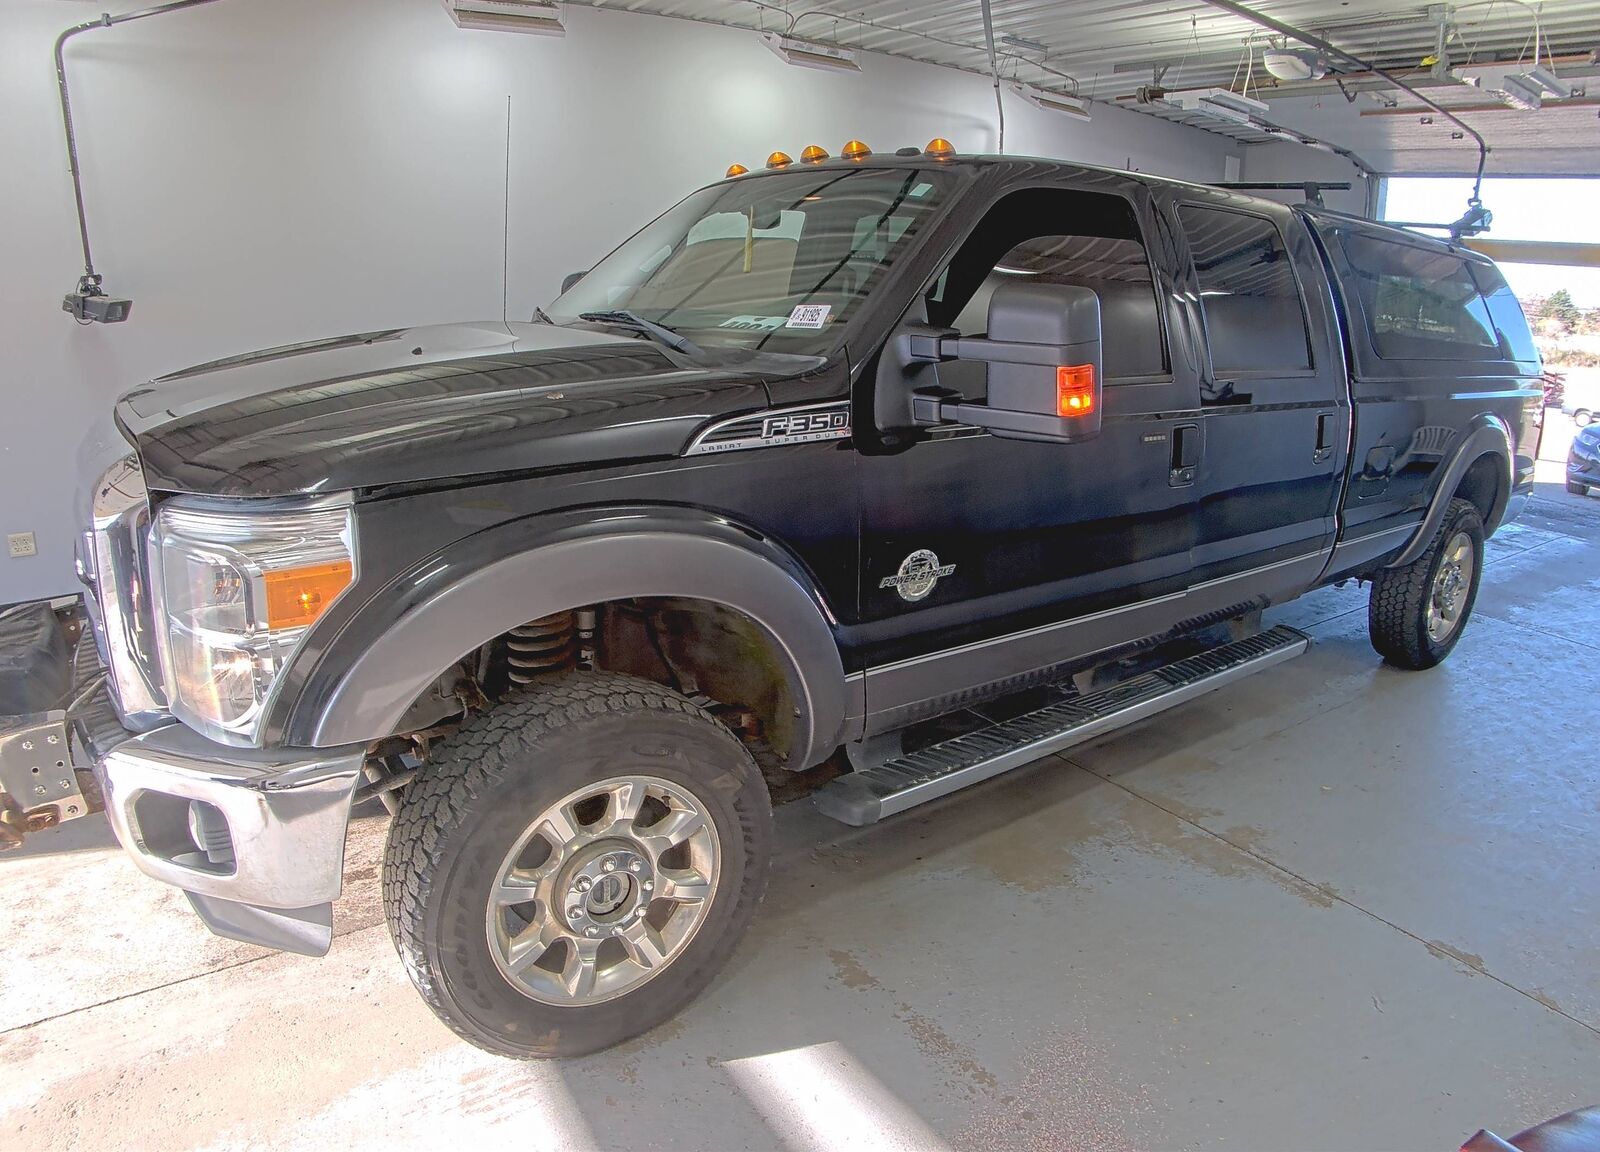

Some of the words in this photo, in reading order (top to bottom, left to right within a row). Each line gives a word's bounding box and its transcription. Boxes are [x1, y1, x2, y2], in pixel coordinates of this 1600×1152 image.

[765, 435, 808, 445] SUPER
[816, 431, 847, 440] DUTY
[701, 442, 742, 452] LARIAT
[883, 573, 917, 586] POWER
[918, 566, 955, 580] STROKE
